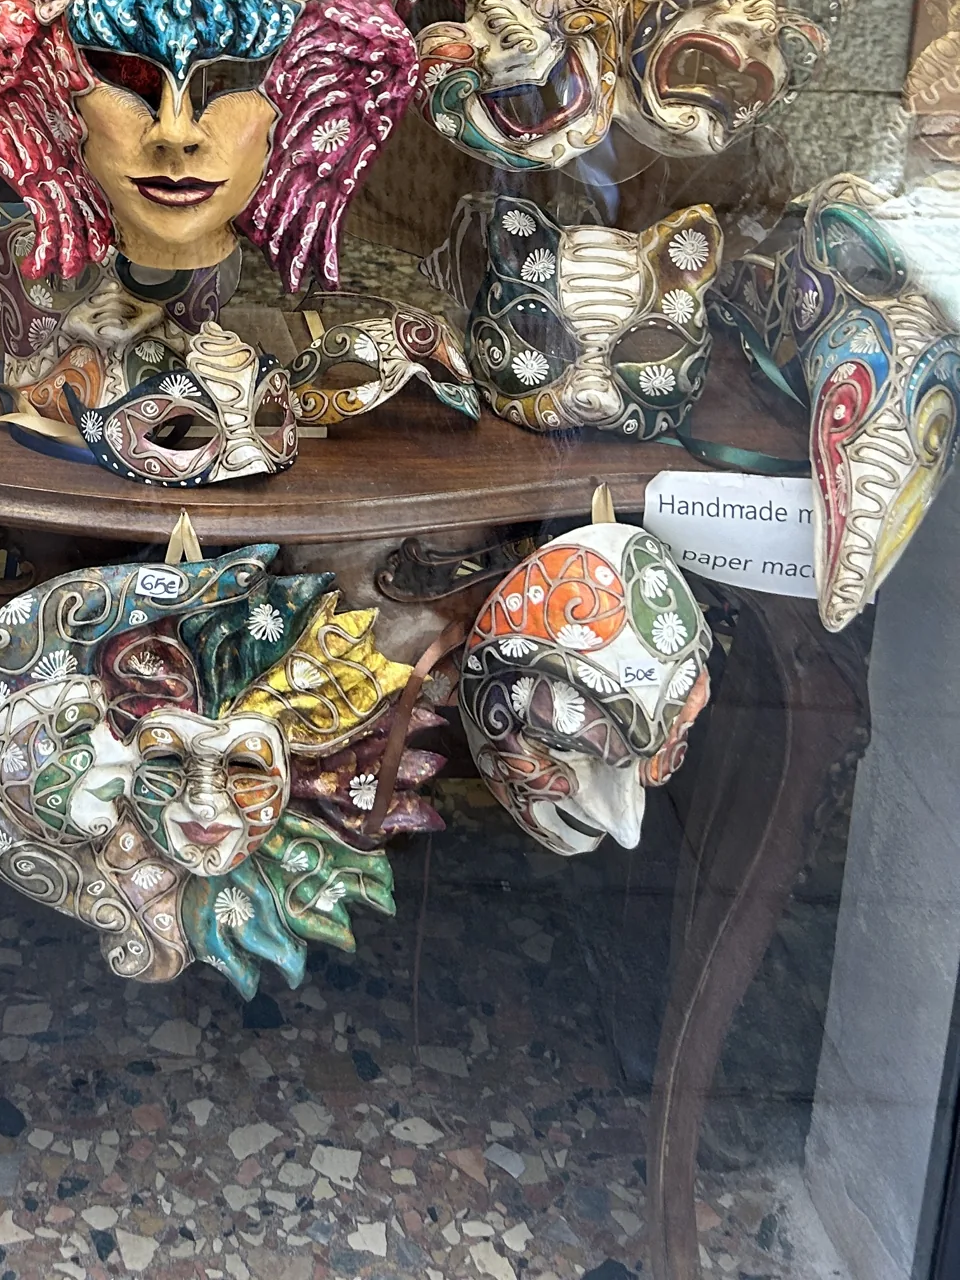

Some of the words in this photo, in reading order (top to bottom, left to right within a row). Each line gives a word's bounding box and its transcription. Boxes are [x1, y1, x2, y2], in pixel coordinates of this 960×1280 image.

[658, 494, 788, 522] Handmade
[682, 548, 753, 571] paper
[624, 666, 658, 683] 50€
